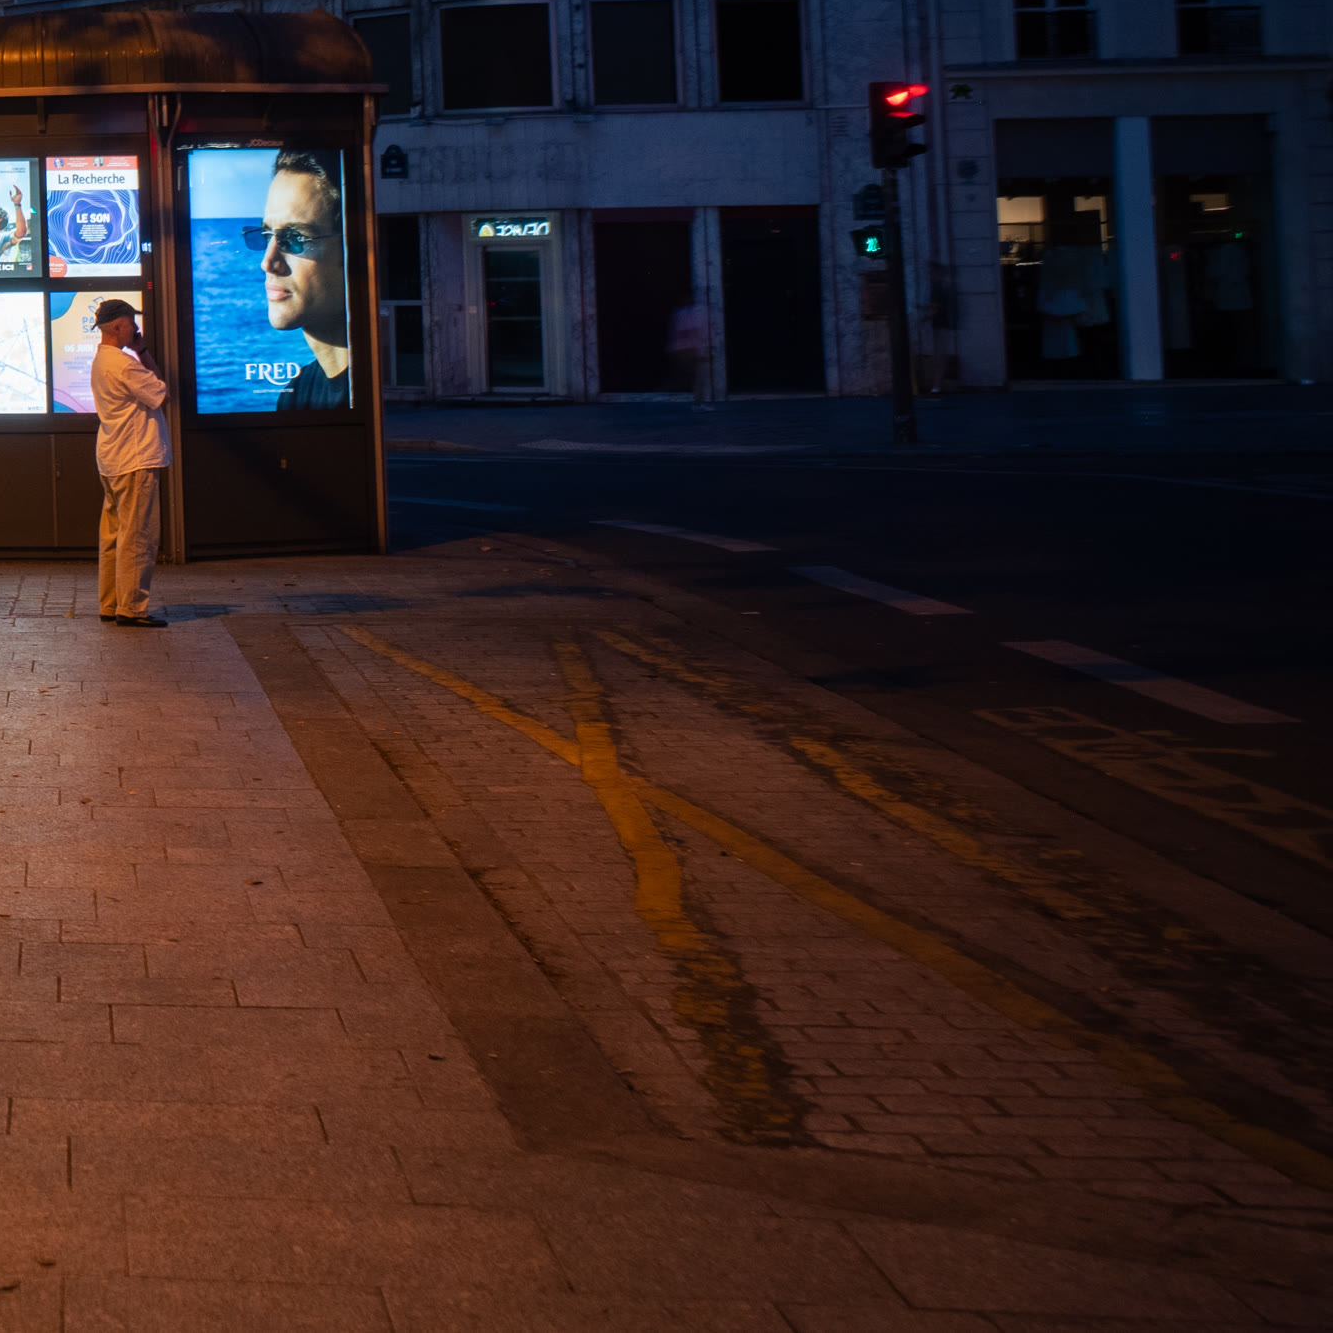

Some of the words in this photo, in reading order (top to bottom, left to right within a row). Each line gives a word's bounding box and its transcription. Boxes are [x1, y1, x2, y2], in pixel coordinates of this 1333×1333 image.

[58, 174, 69, 185] La
[72, 173, 125, 185] Recherche
[76, 213, 88, 224] LE
[90, 213, 111, 224] SON
[245, 362, 301, 385] FRED
